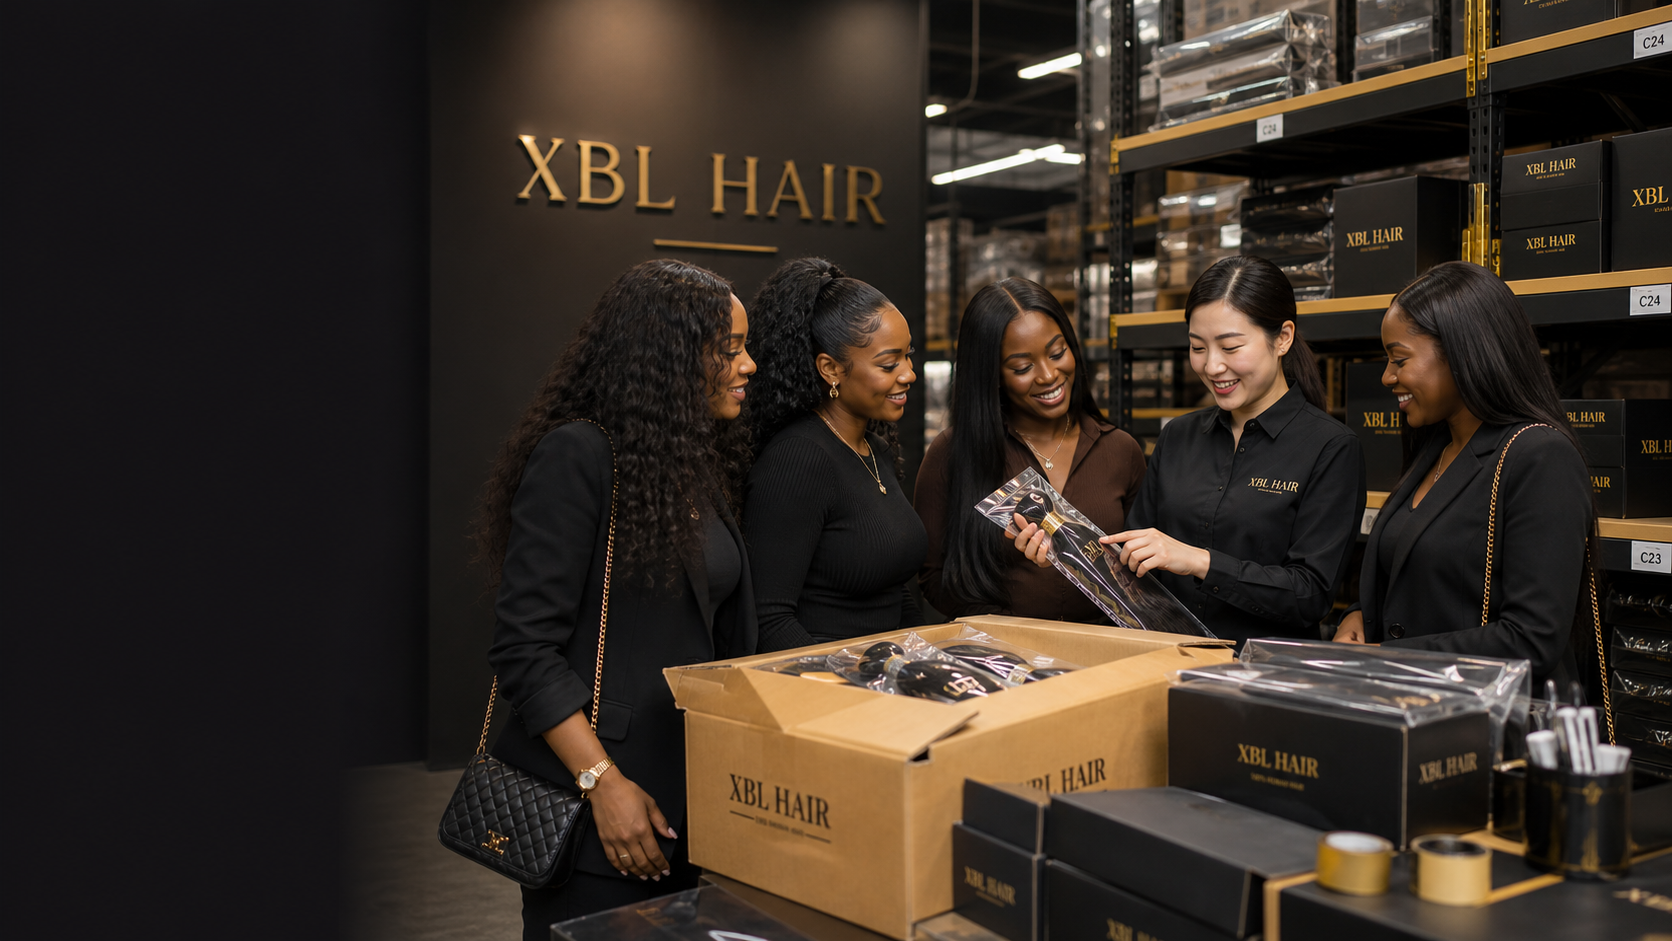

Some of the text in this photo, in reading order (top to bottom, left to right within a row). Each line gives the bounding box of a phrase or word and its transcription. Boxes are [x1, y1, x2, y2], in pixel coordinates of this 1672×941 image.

[1643, 34, 1664, 49] C24
[1526, 162, 1547, 176] XBL
[1549, 157, 1577, 172] HAIR
[516, 134, 886, 225] XBL HAIR
[1632, 186, 1669, 207] XBL
[1346, 226, 1404, 247] XBL HAIR
[1526, 233, 1576, 250] XBL HAIR
[1640, 295, 1661, 307] C24
[1363, 411, 1388, 427] XBL
[1566, 411, 1606, 423] BL HAIR
[1641, 440, 1662, 454] XBL
[1247, 477, 1269, 488] XBL
[1271, 479, 1299, 493] HAIR
[1590, 476, 1611, 488] AIR
[1640, 552, 1662, 565] C23
[1237, 743, 1319, 780] XBL HAIR
[1061, 758, 1107, 794] HAIR
[729, 773, 769, 811] XBL
[775, 785, 832, 830] HAIR
